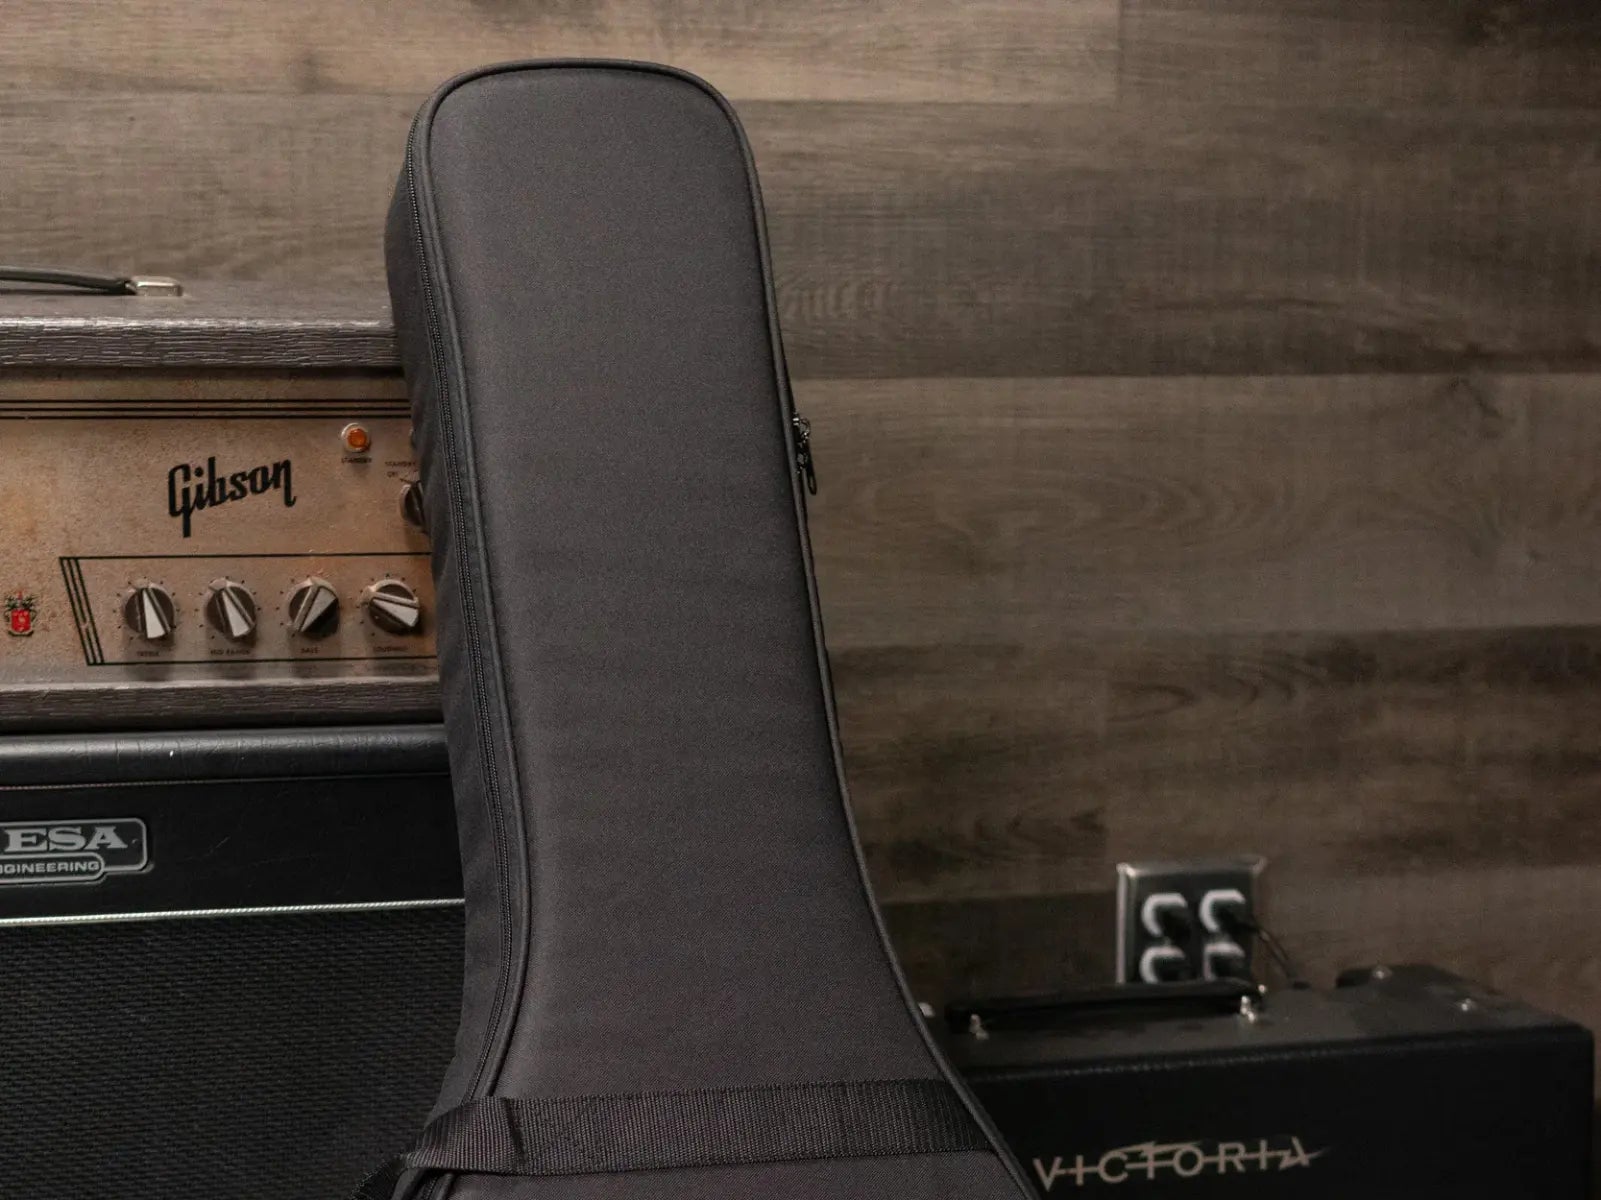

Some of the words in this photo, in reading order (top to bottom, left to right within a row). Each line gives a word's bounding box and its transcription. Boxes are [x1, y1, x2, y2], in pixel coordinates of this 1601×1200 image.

[168, 456, 297, 538] Gibson
[0, 861, 100, 874] GINEERING
[1033, 1136, 1312, 1192] VICTORIA
